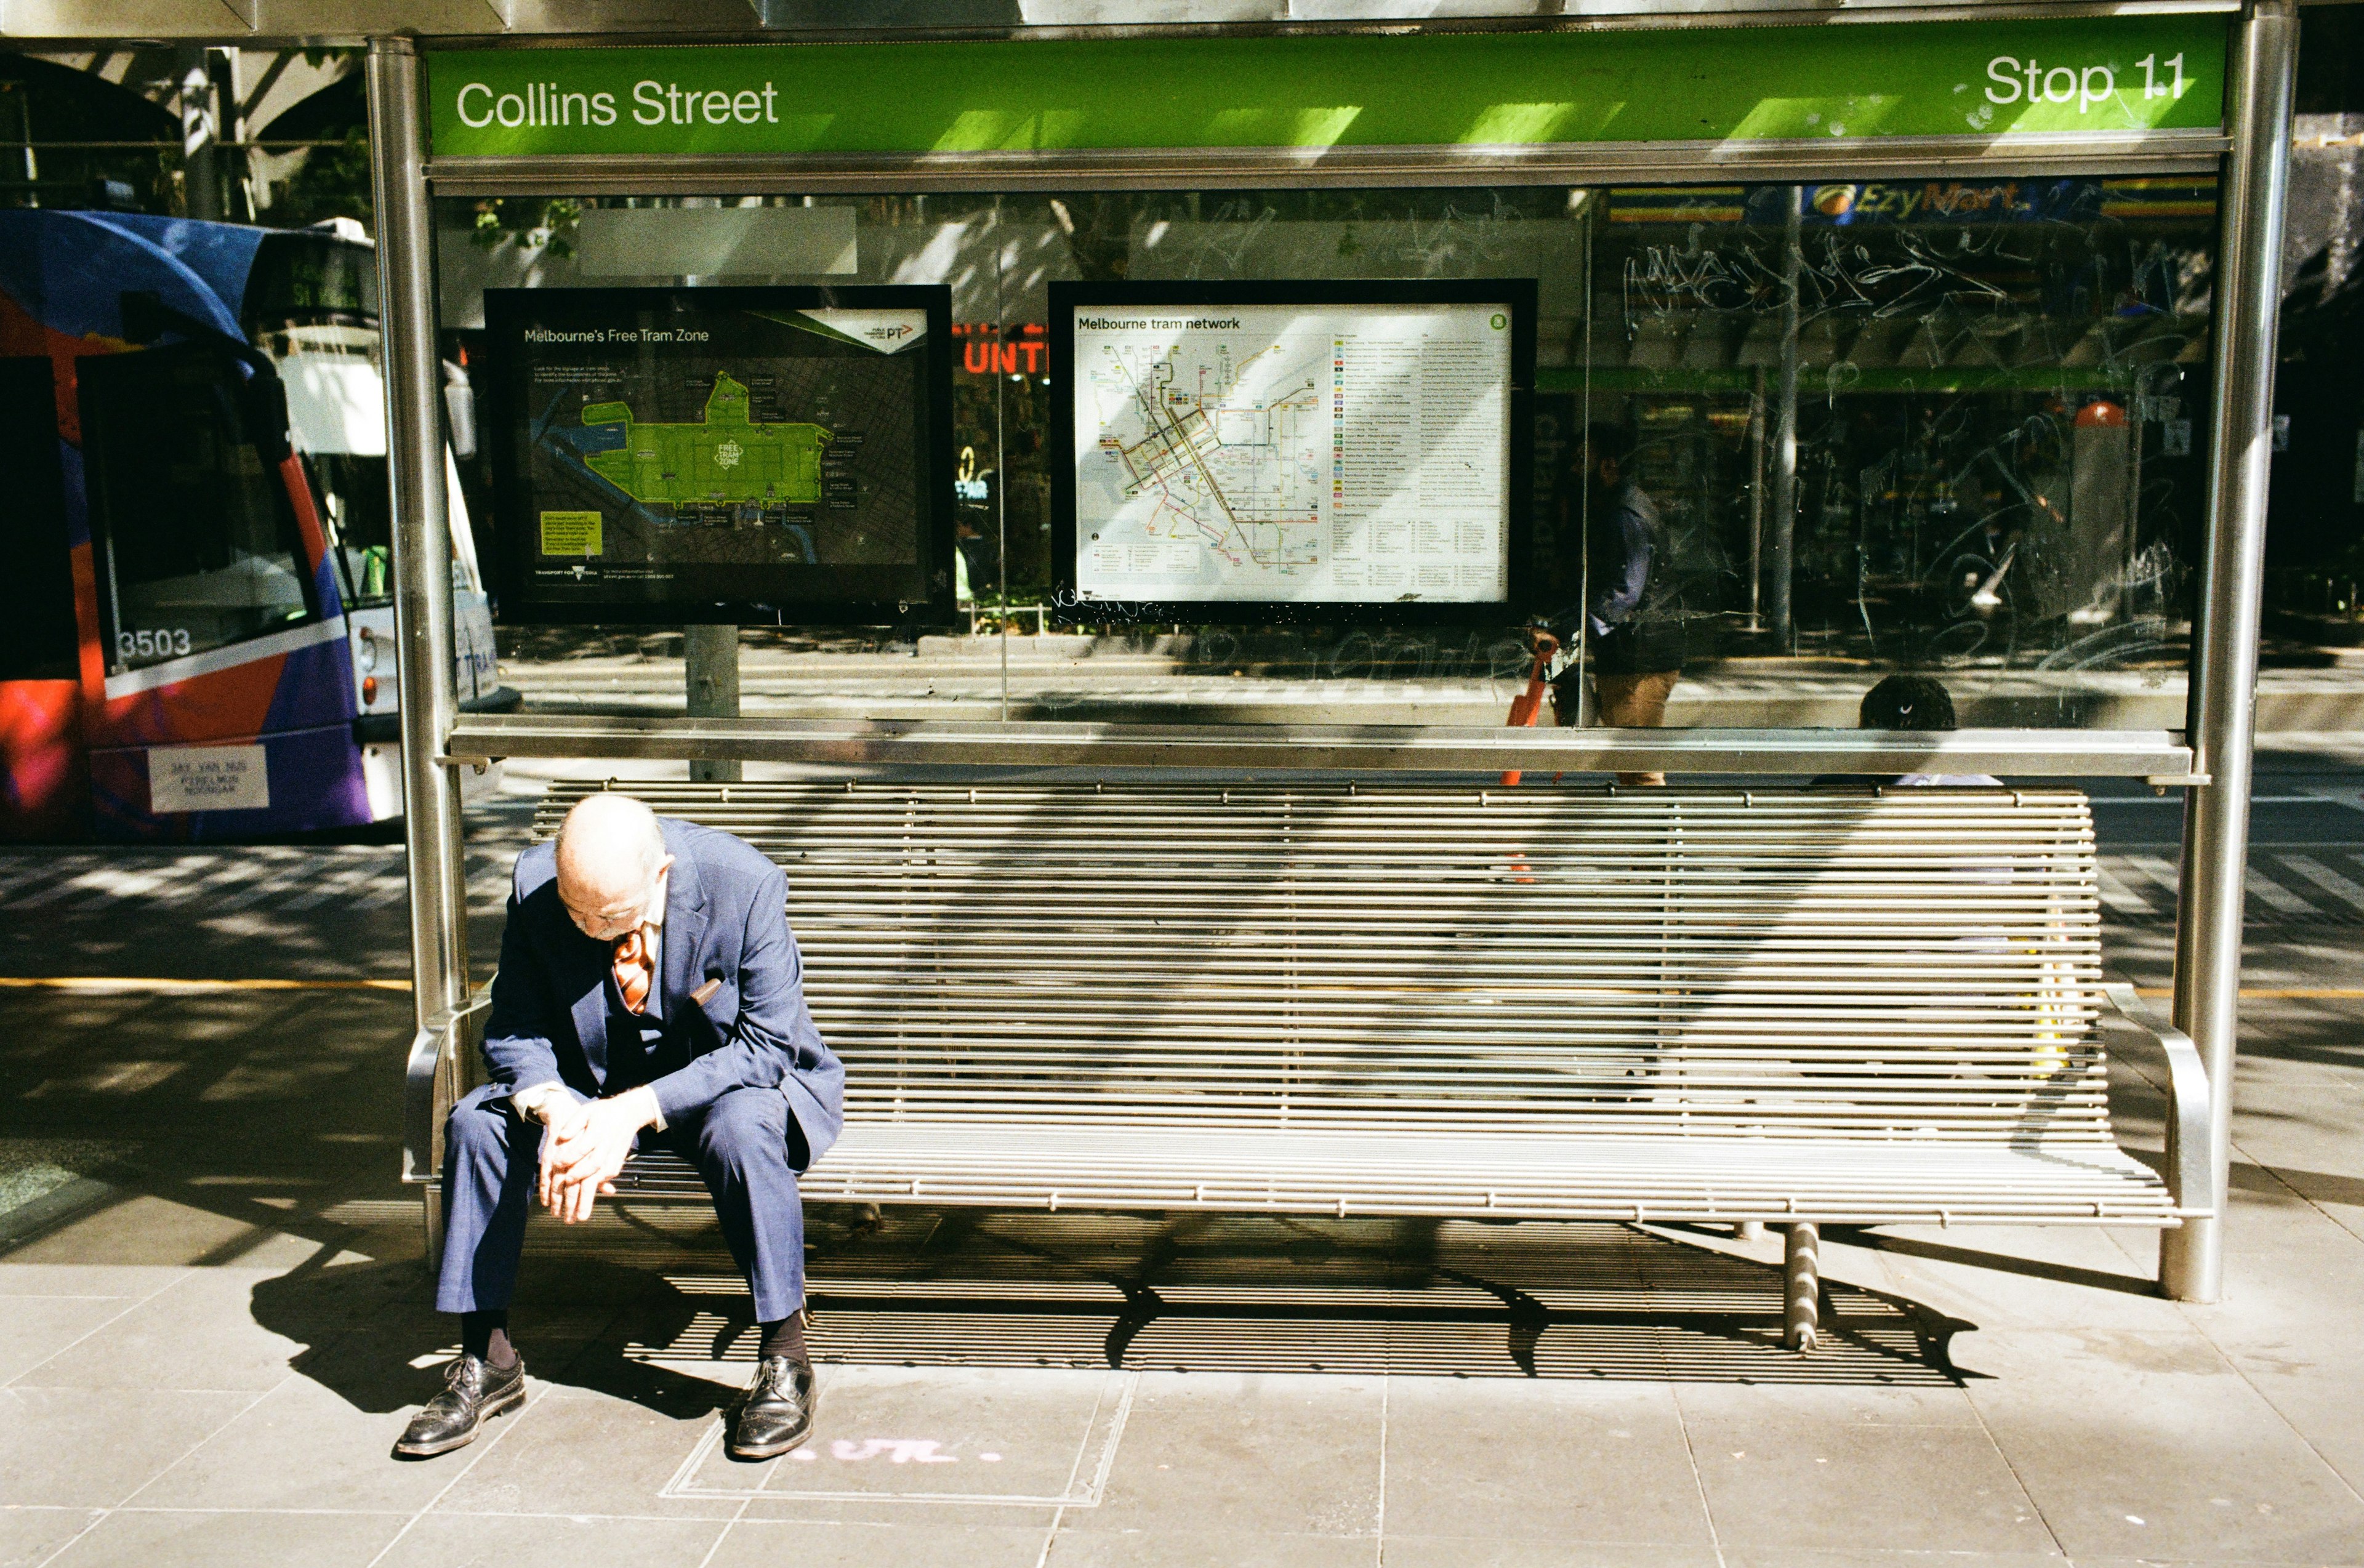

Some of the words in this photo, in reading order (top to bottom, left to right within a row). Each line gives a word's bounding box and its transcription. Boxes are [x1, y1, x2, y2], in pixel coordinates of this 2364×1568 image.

[1984, 56, 2114, 114] Stop
[2134, 52, 2184, 100] 11
[457, 82, 617, 128] Collins
[632, 79, 779, 126] Street
[525, 329, 605, 342] Melbourne's
[608, 329, 638, 342] Free
[640, 329, 673, 342] Tram
[677, 329, 709, 342] Zone
[1079, 318, 1147, 330] Melbourne
[1151, 319, 1183, 330] tram
[1186, 316, 1240, 330] network
[118, 628, 191, 658] 3503
